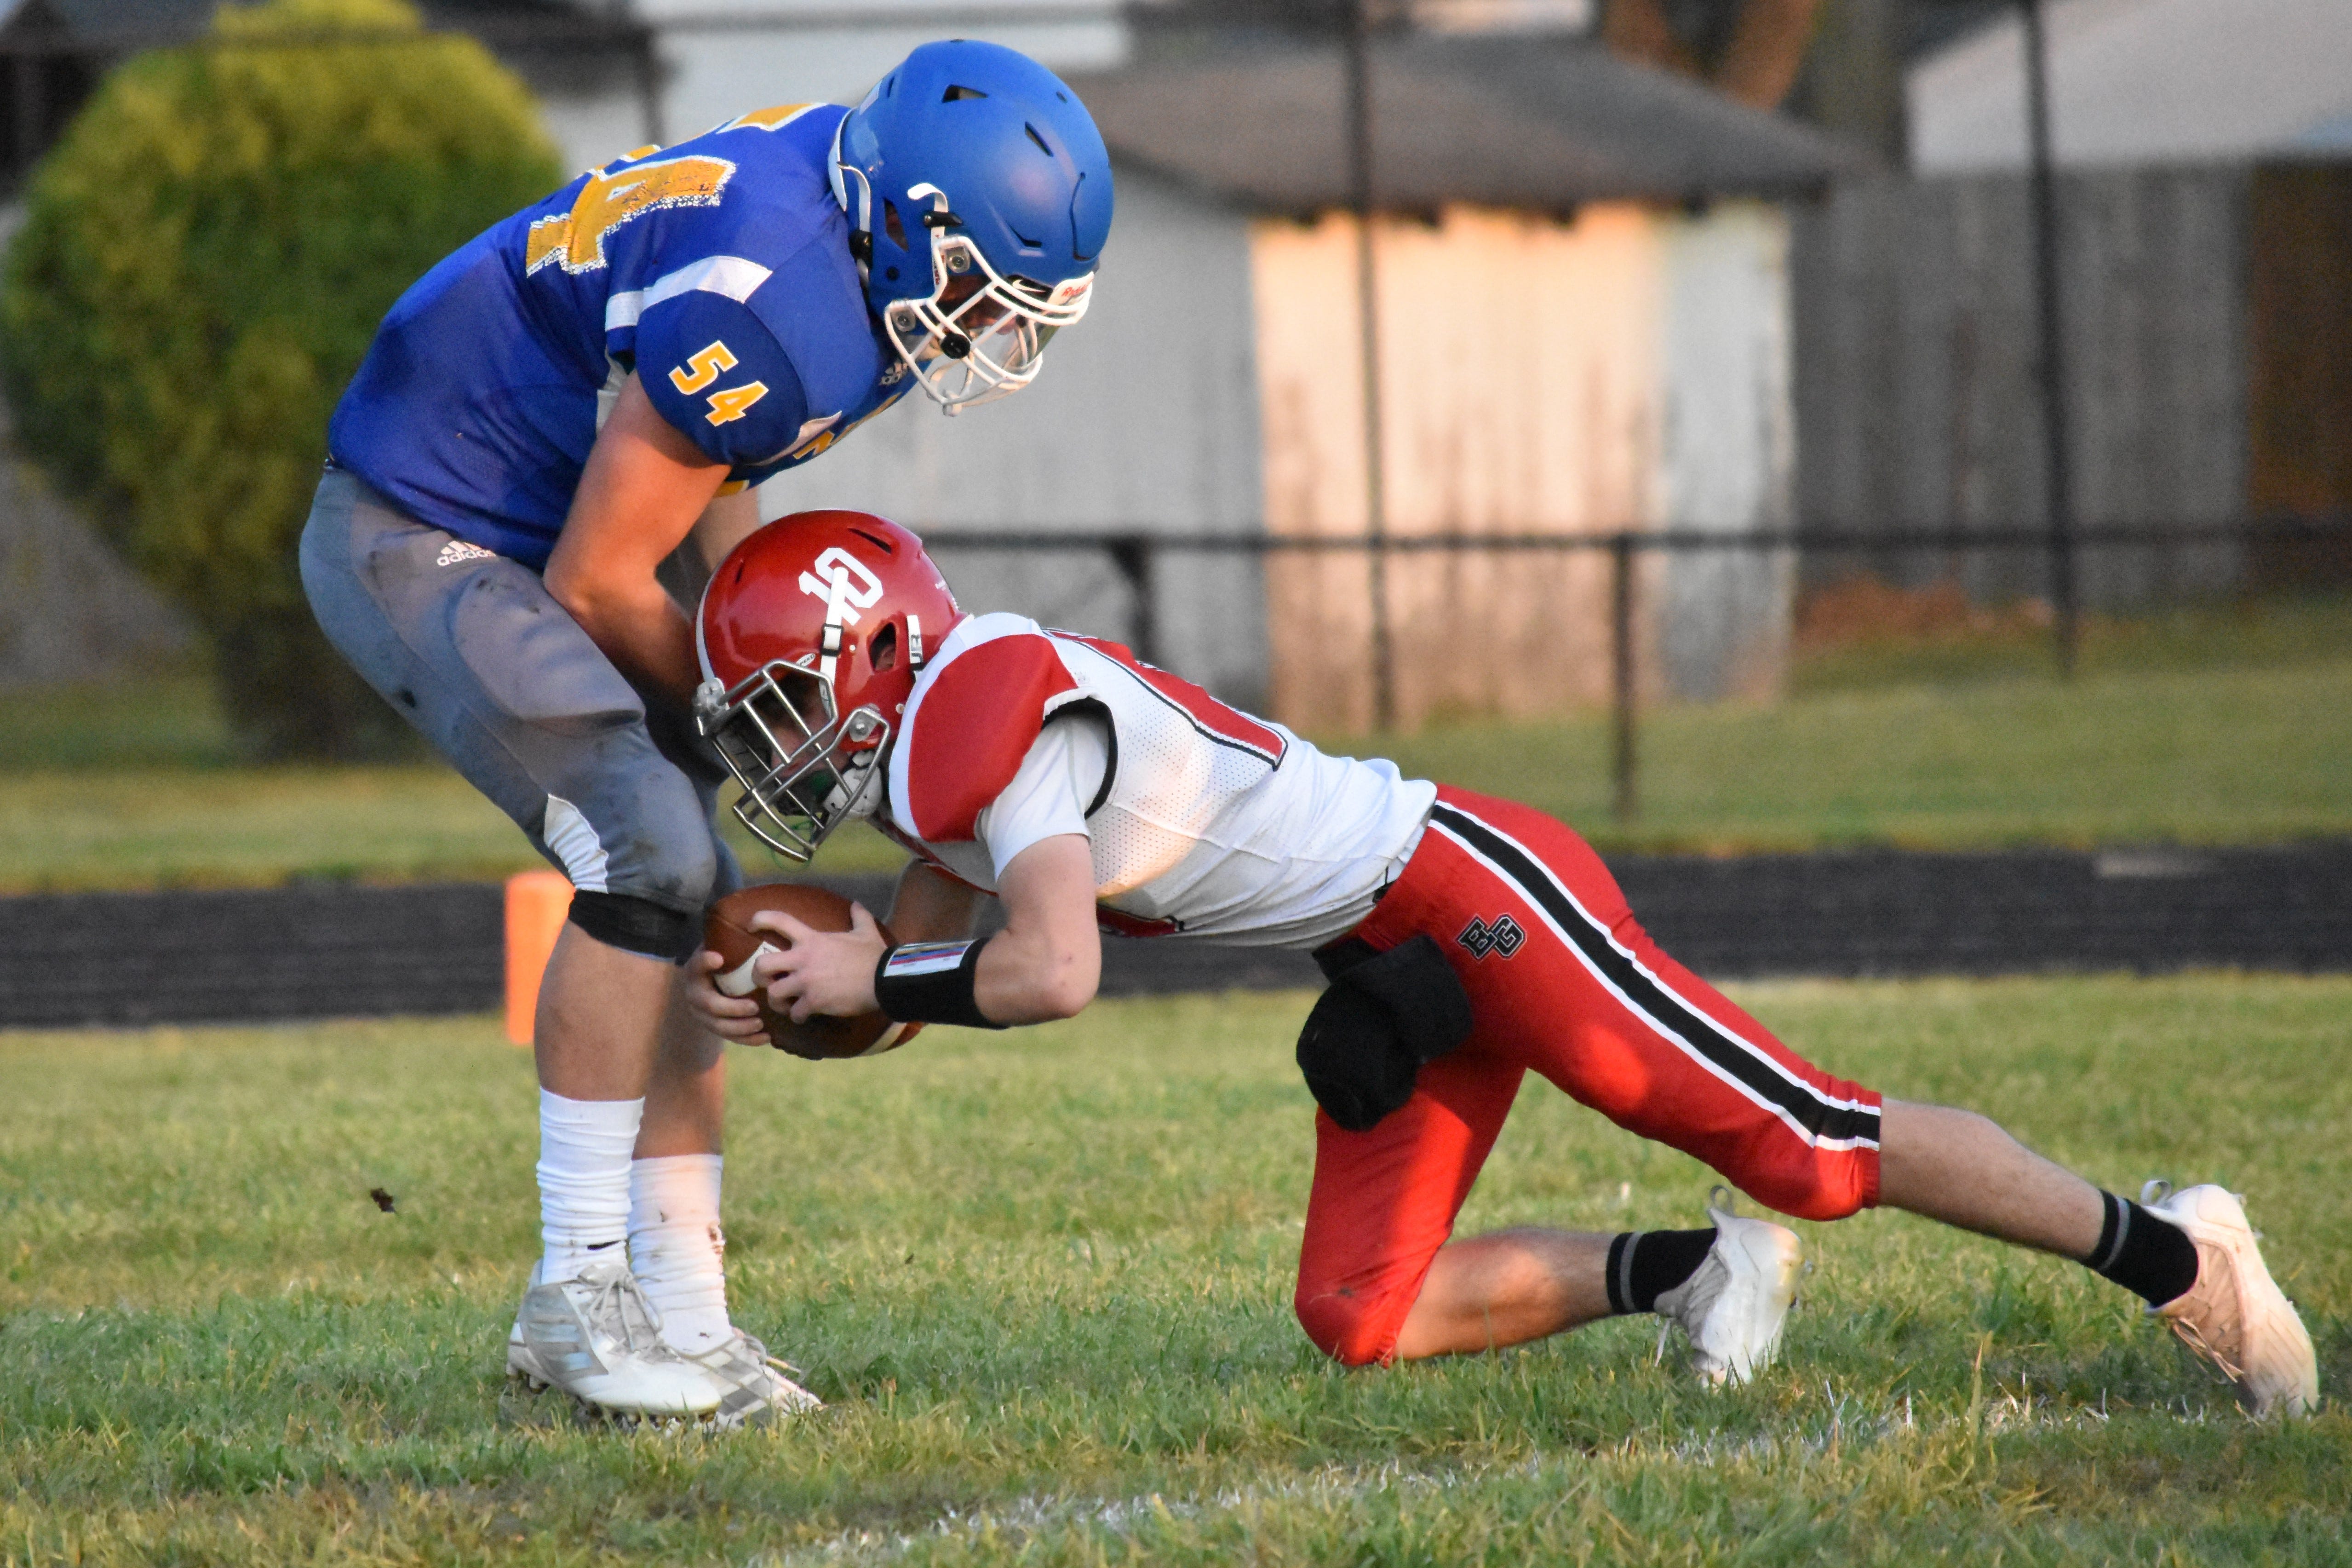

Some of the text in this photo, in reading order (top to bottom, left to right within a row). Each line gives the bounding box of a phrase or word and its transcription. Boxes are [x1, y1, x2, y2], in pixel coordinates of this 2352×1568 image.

[668, 340, 769, 426] 54
[798, 546, 883, 626] 10
[1456, 914, 1526, 961] BG
